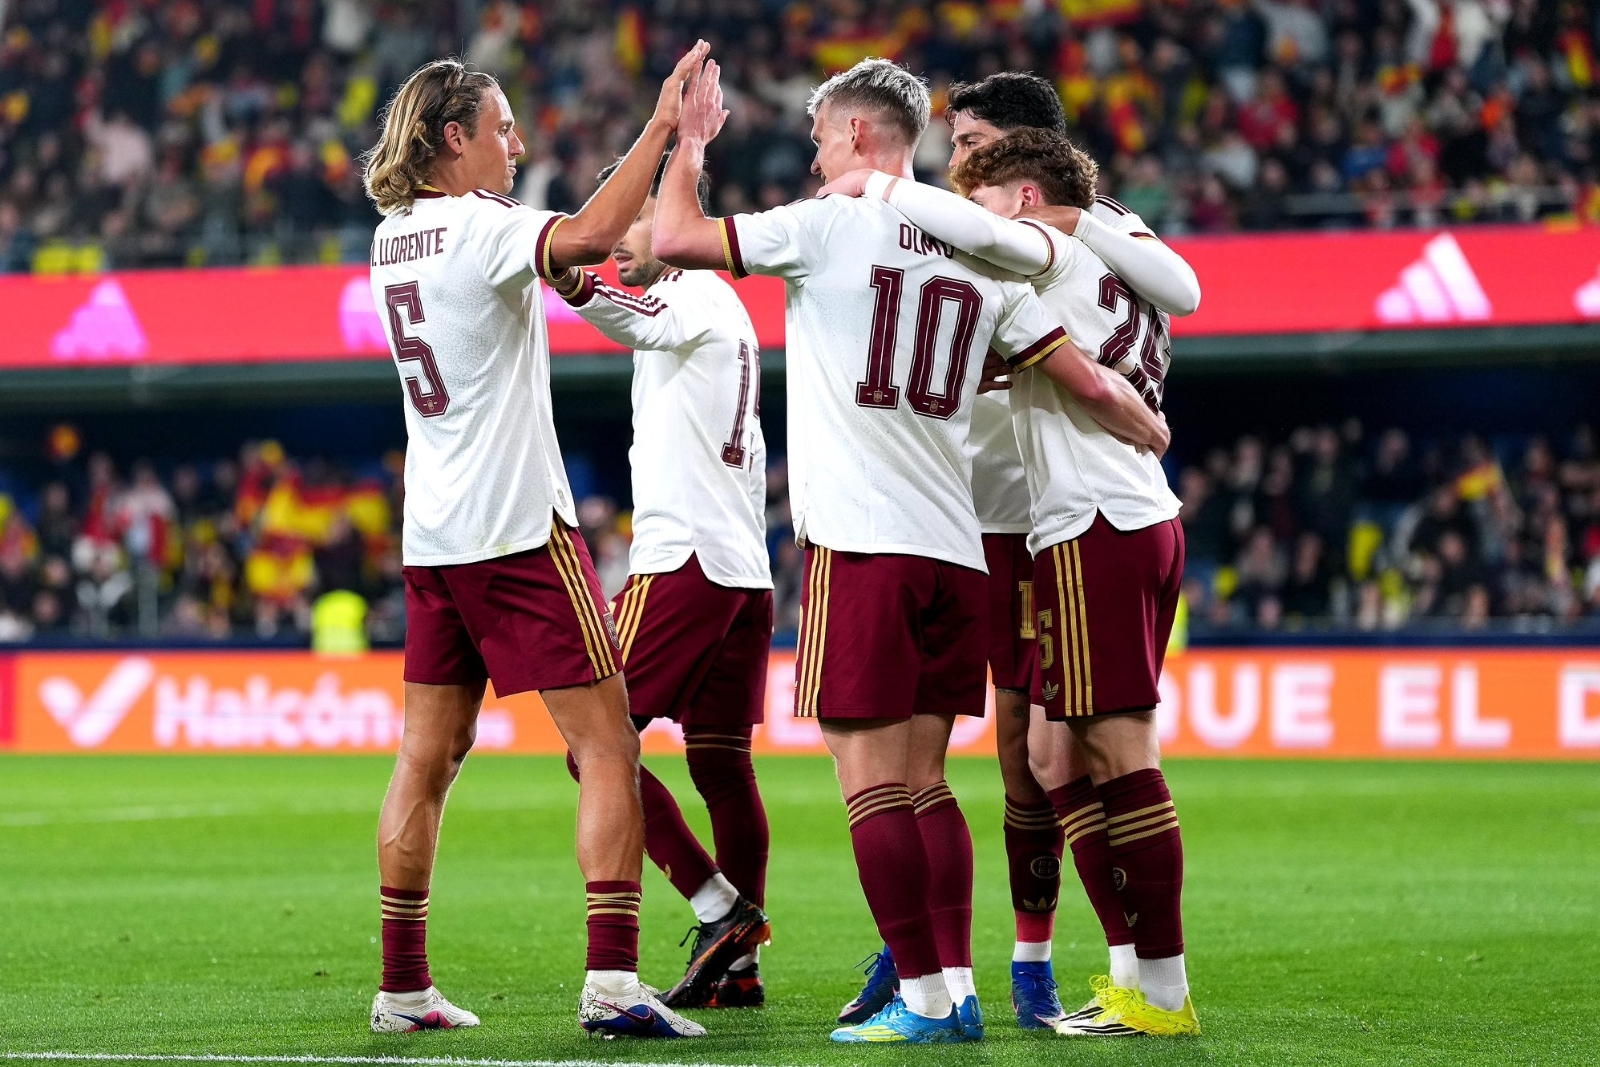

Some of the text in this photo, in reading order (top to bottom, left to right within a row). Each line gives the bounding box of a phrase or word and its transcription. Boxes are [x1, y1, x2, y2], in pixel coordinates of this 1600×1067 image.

[380, 227, 447, 266] LLORENTE
[385, 280, 450, 418] 5
[856, 264, 983, 421] 10
[720, 339, 761, 474] 1
[153, 672, 394, 748] Halcón
[1378, 662, 1512, 749] EL
